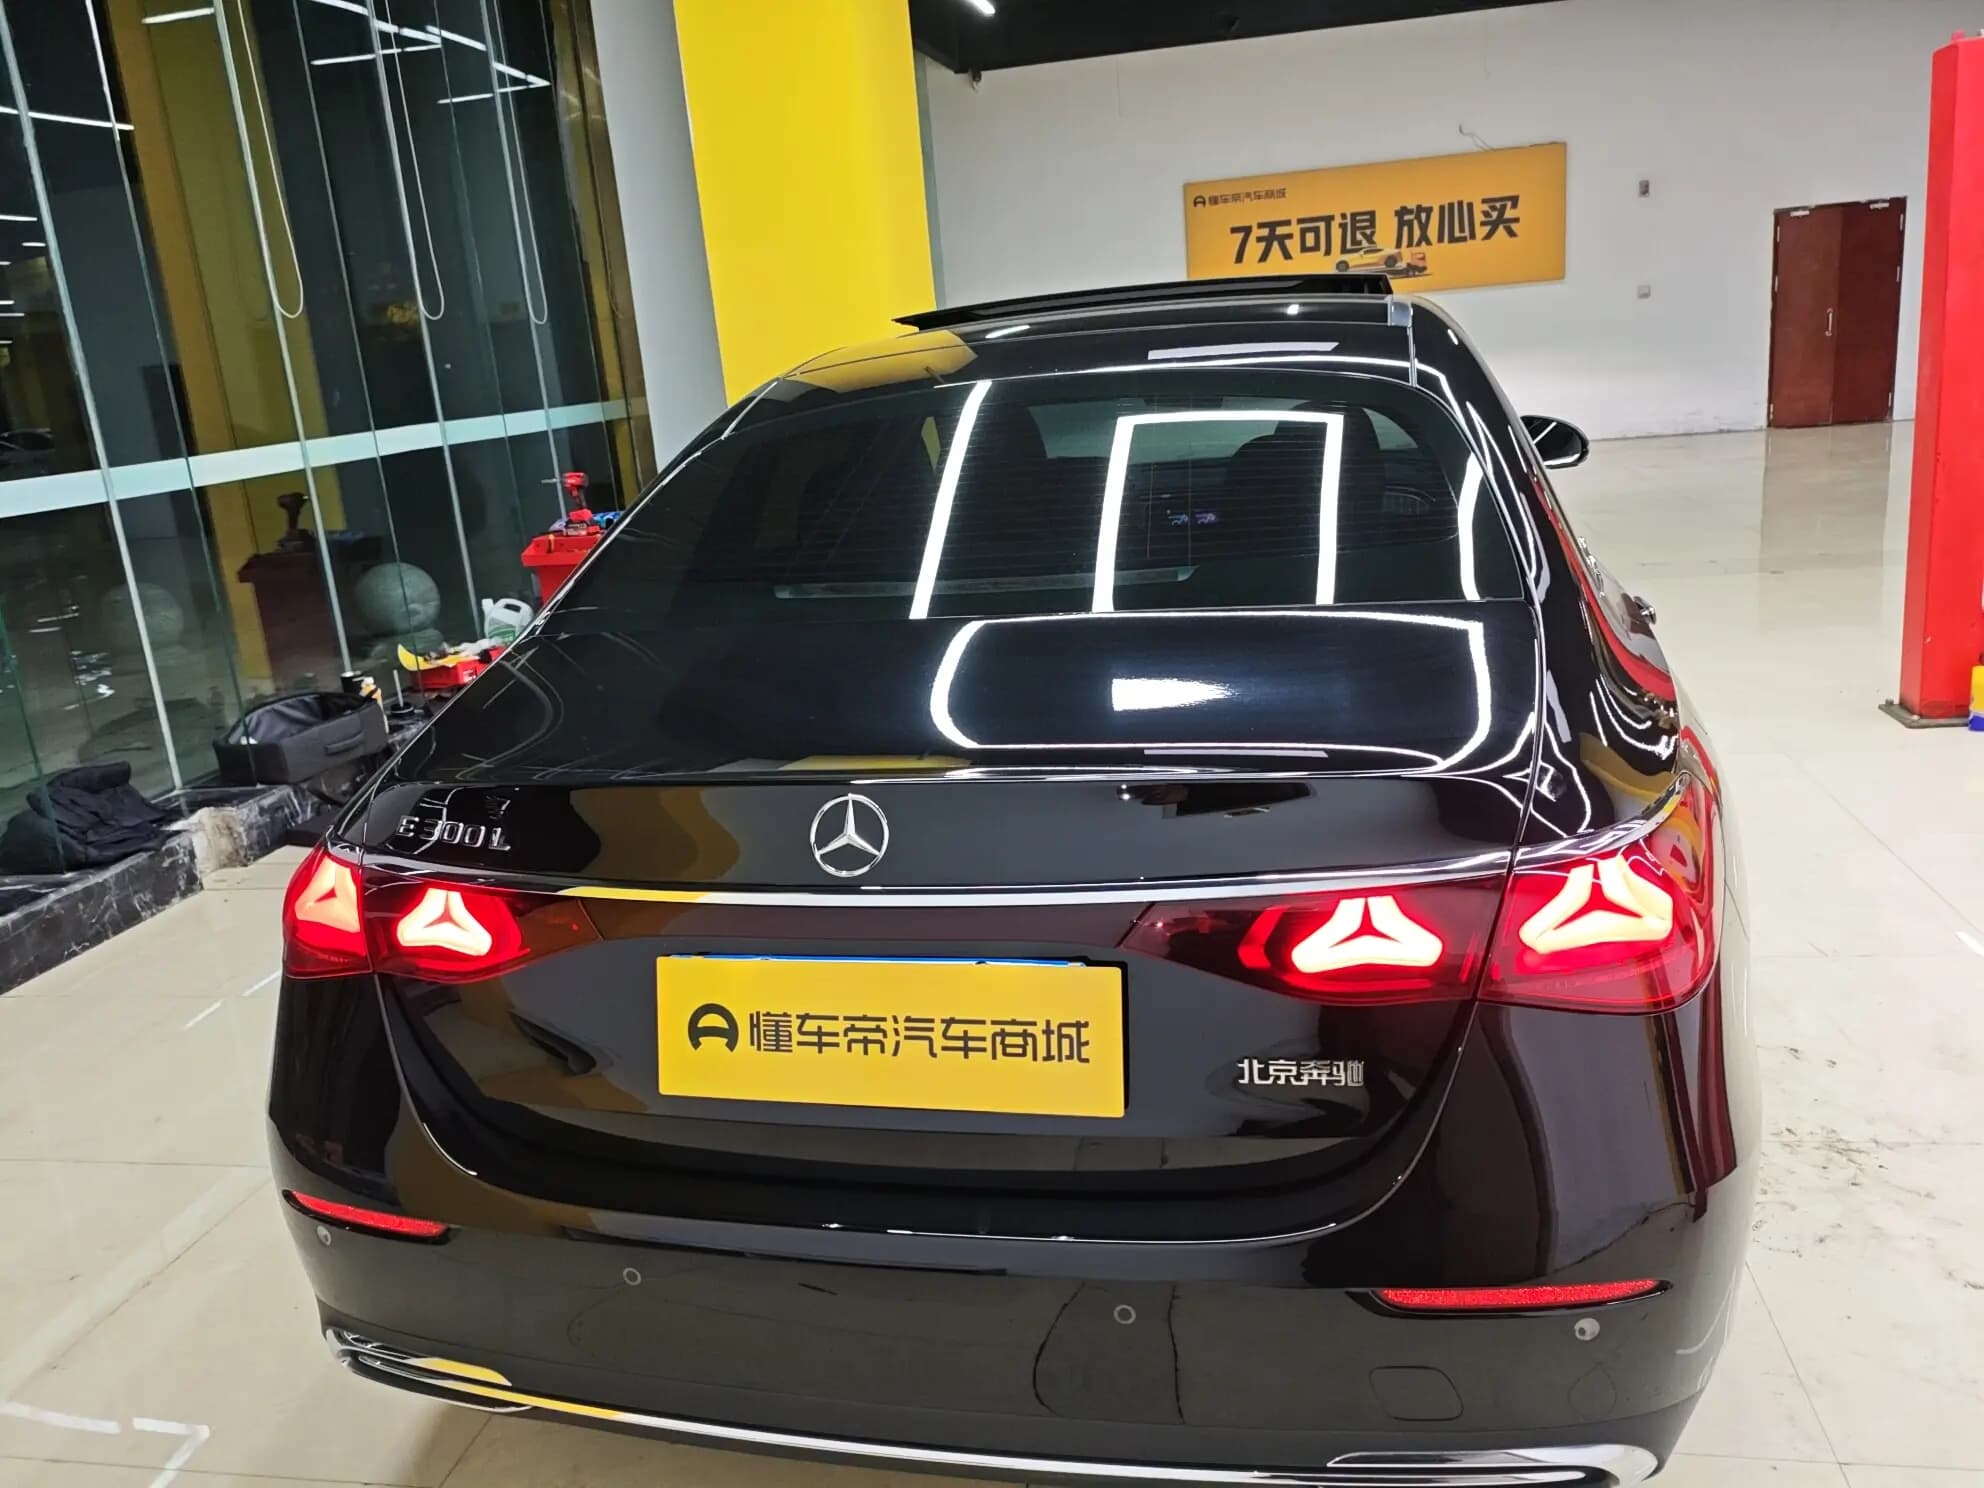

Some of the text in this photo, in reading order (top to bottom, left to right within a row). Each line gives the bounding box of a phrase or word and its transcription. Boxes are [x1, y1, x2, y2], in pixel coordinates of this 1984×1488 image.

[1230, 195, 1521, 264] 7天可退 放心买
[749, 1011, 1091, 1063] 懂车帝汽车商城
[1237, 1058, 1364, 1087] 北京奔驰
